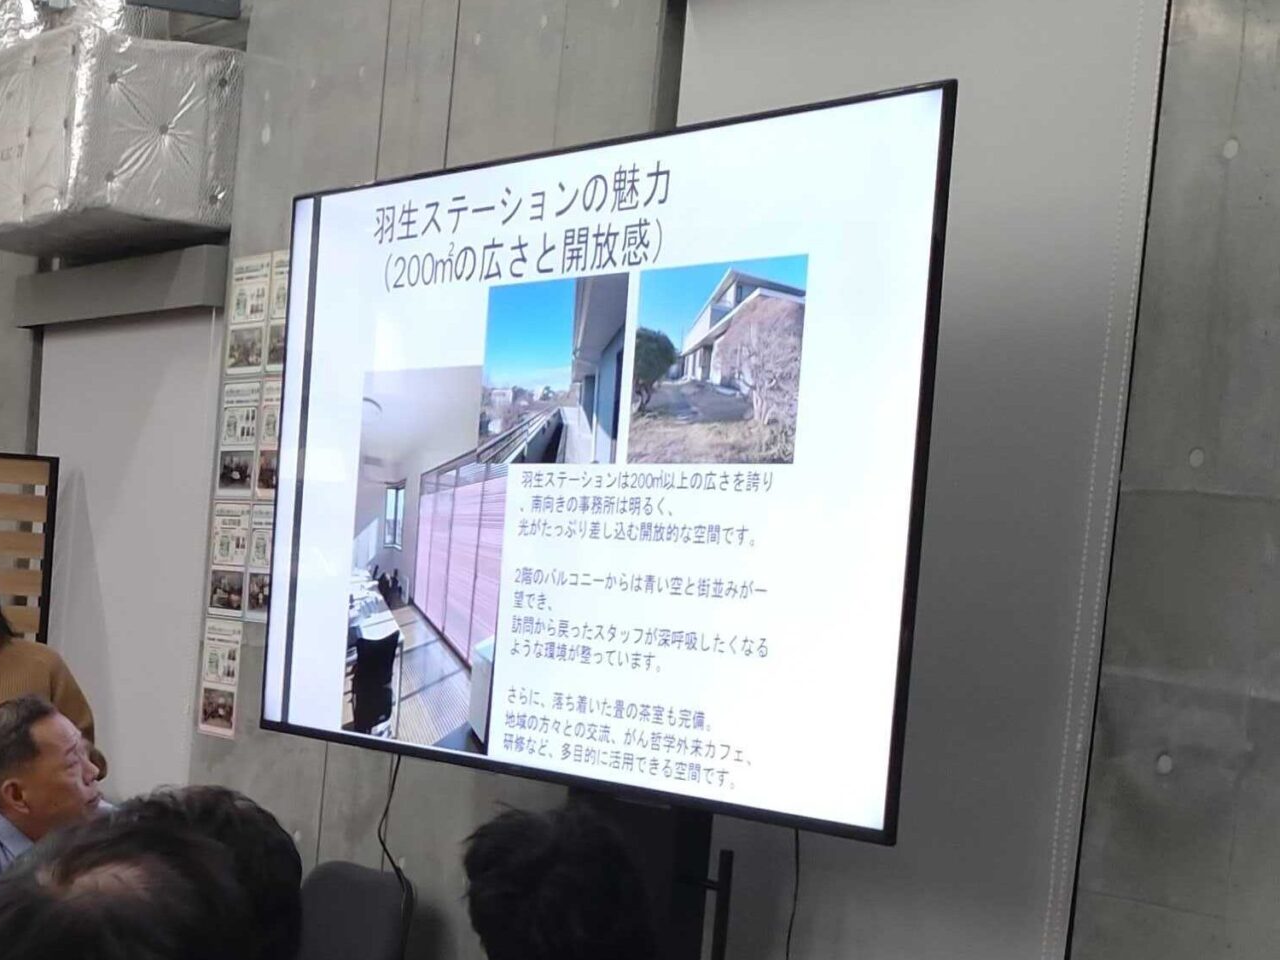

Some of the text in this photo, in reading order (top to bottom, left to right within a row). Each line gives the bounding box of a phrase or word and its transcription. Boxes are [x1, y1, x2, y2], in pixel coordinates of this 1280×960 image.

[374, 160, 671, 245] 羽生ステーションの魅力
[517, 518, 755, 547] 光がたっぷり差し込む開放的な空間です。
[513, 591, 552, 611] 望でき、
[514, 567, 768, 600] 2階のバルコニーからは青い空と街並みが一
[510, 640, 661, 673] ような環境が整っています。
[511, 615, 768, 658] 訪問から戻ったスタッフが深呼吸したくなる
[507, 685, 711, 732] さらに、落ち着いた畳の茶室も完備。
[505, 710, 751, 766] 地域の方々との交流、がん哲学外来カフェ、
[503, 733, 735, 790] 研修など、多目的に活用できる空間です。
